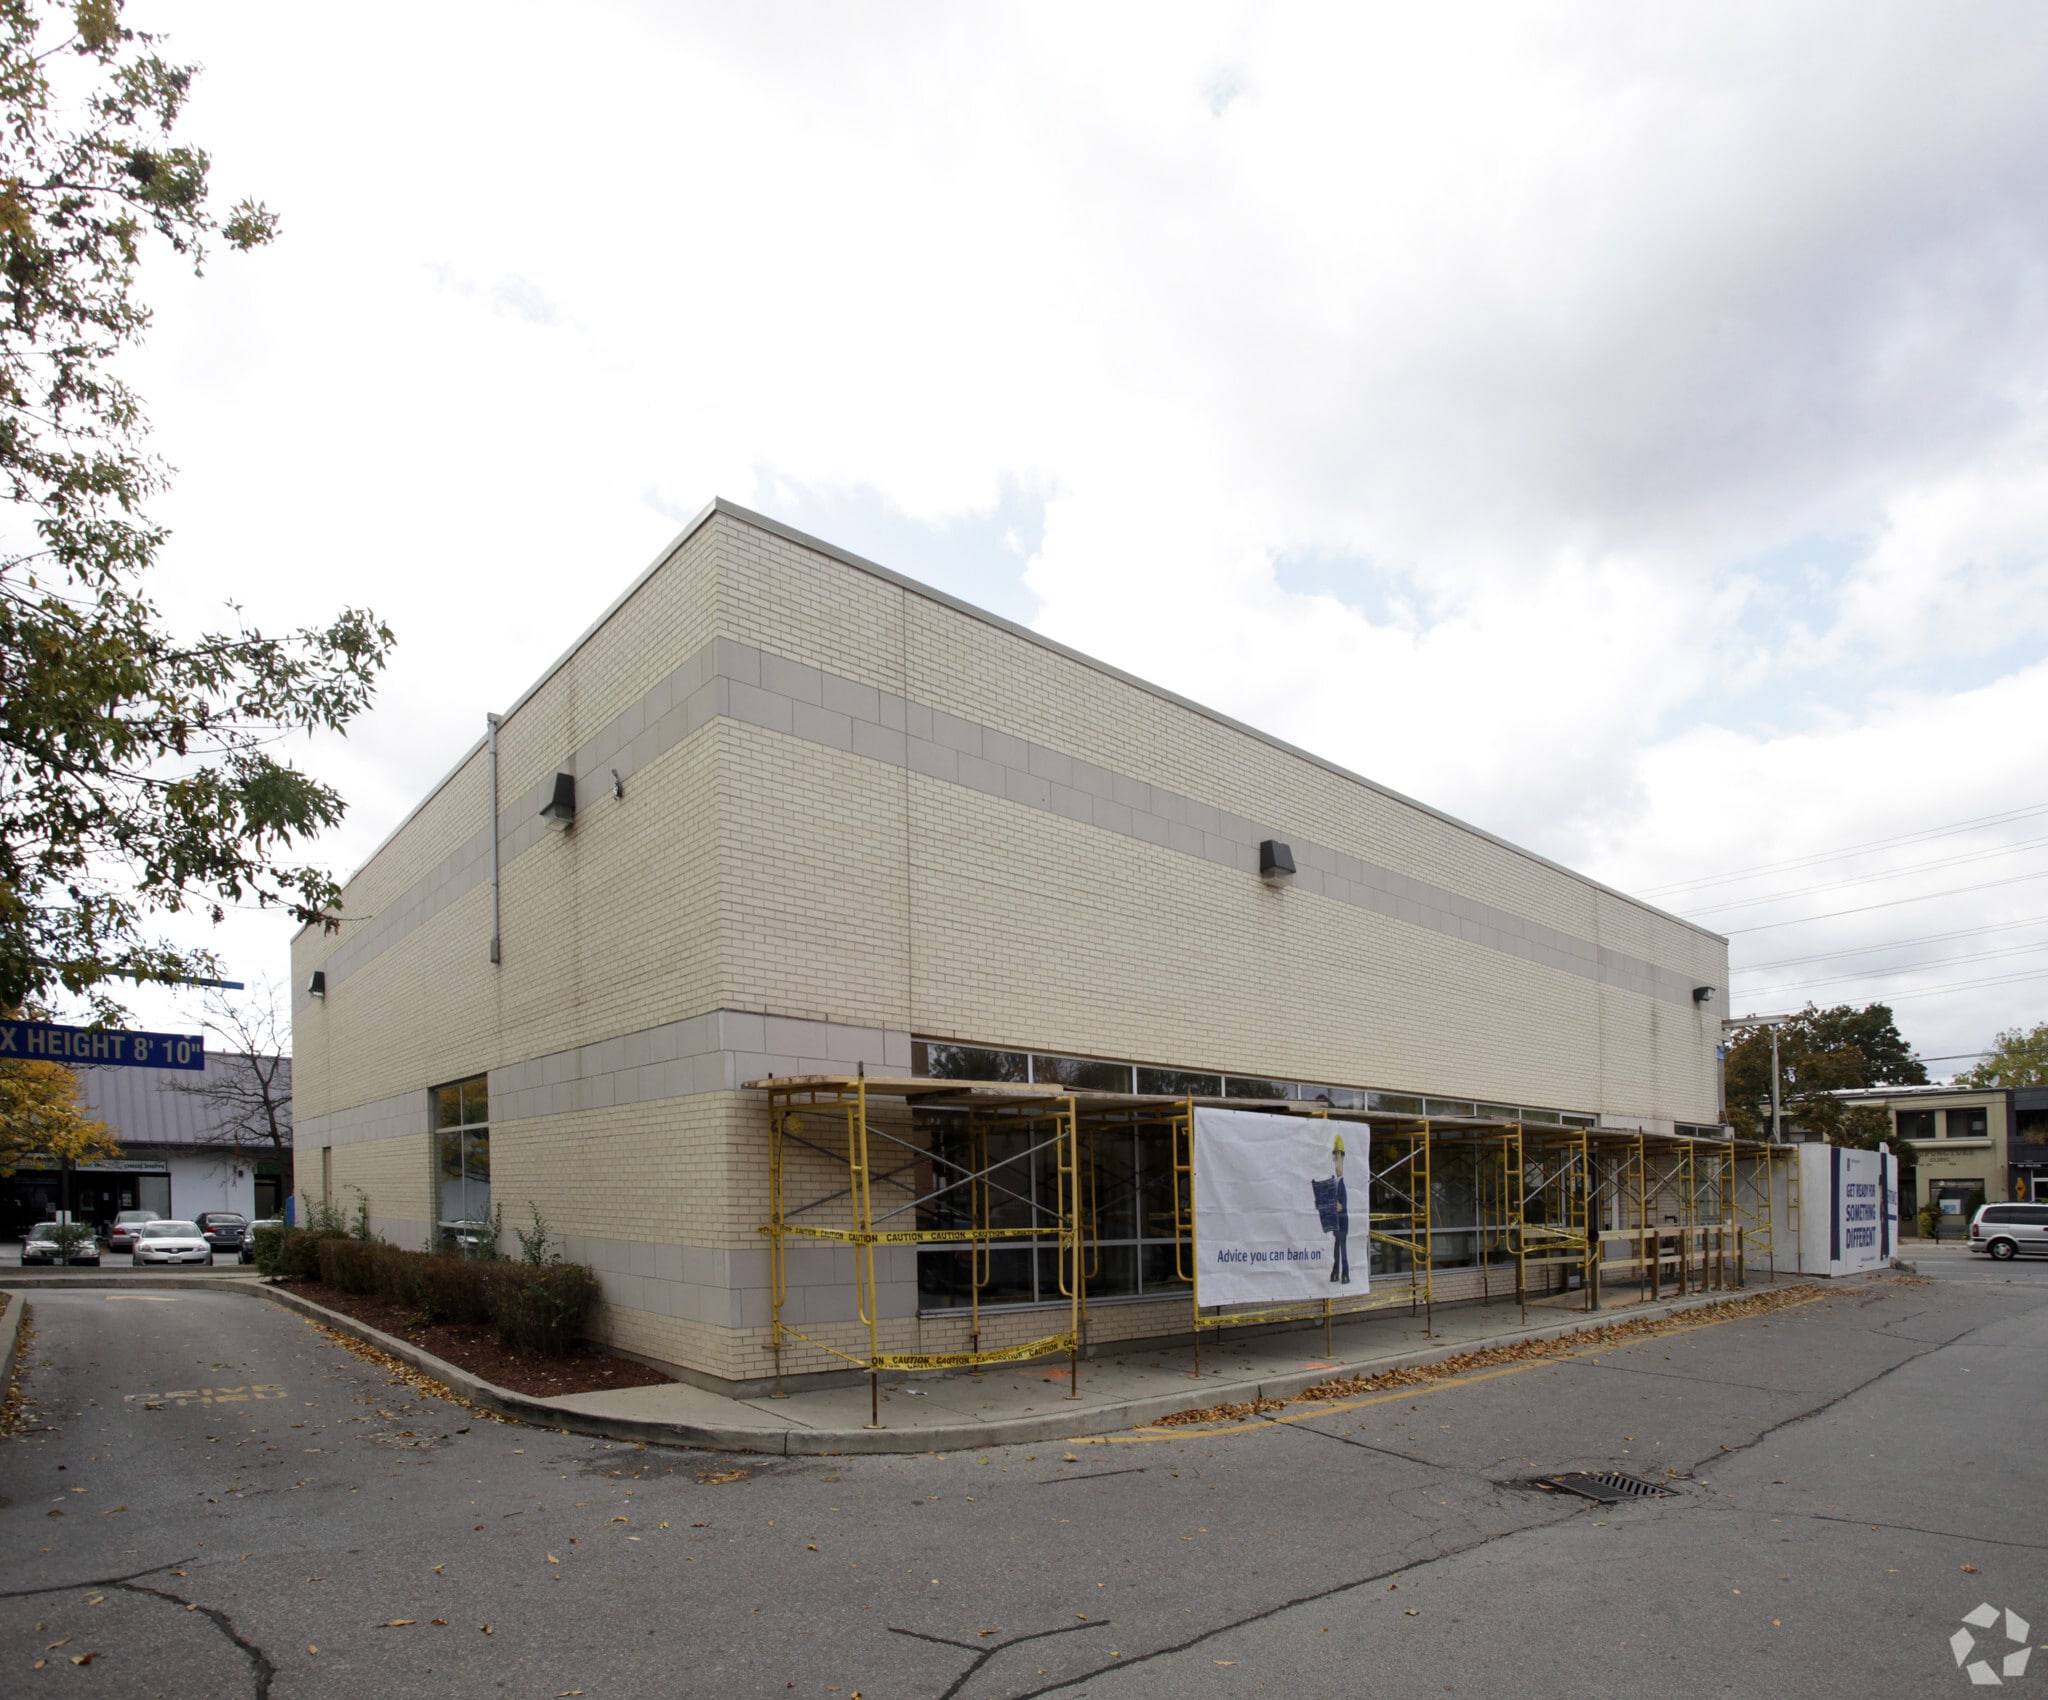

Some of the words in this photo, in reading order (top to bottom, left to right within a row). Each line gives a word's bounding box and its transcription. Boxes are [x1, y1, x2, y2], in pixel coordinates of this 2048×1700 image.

[27, 1028, 126, 1060] HEIGHT
[133, 1037, 154, 1062] 8'
[162, 1039, 201, 1065] 10"
[1846, 1183, 1856, 1197] GET
[1856, 1183, 1868, 1197] READY
[1846, 1204, 1876, 1222] SOMETHING
[820, 1230, 844, 1240] CAUTION
[848, 1232, 878, 1243] CAUTION
[886, 1233, 924, 1242] CAUTION
[930, 1231, 966, 1240] CAUTION
[972, 1230, 1006, 1239] CAUTION
[1846, 1226, 1876, 1249] DIFFERENT
[1217, 1248, 1248, 1263] Advice
[1250, 1251, 1267, 1266] you
[1269, 1250, 1285, 1262] can
[1287, 1248, 1309, 1261] bank
[1029, 1342, 1058, 1357] CAUTION
[892, 1356, 930, 1364] CAUTION
[936, 1356, 970, 1364] CAUTION
